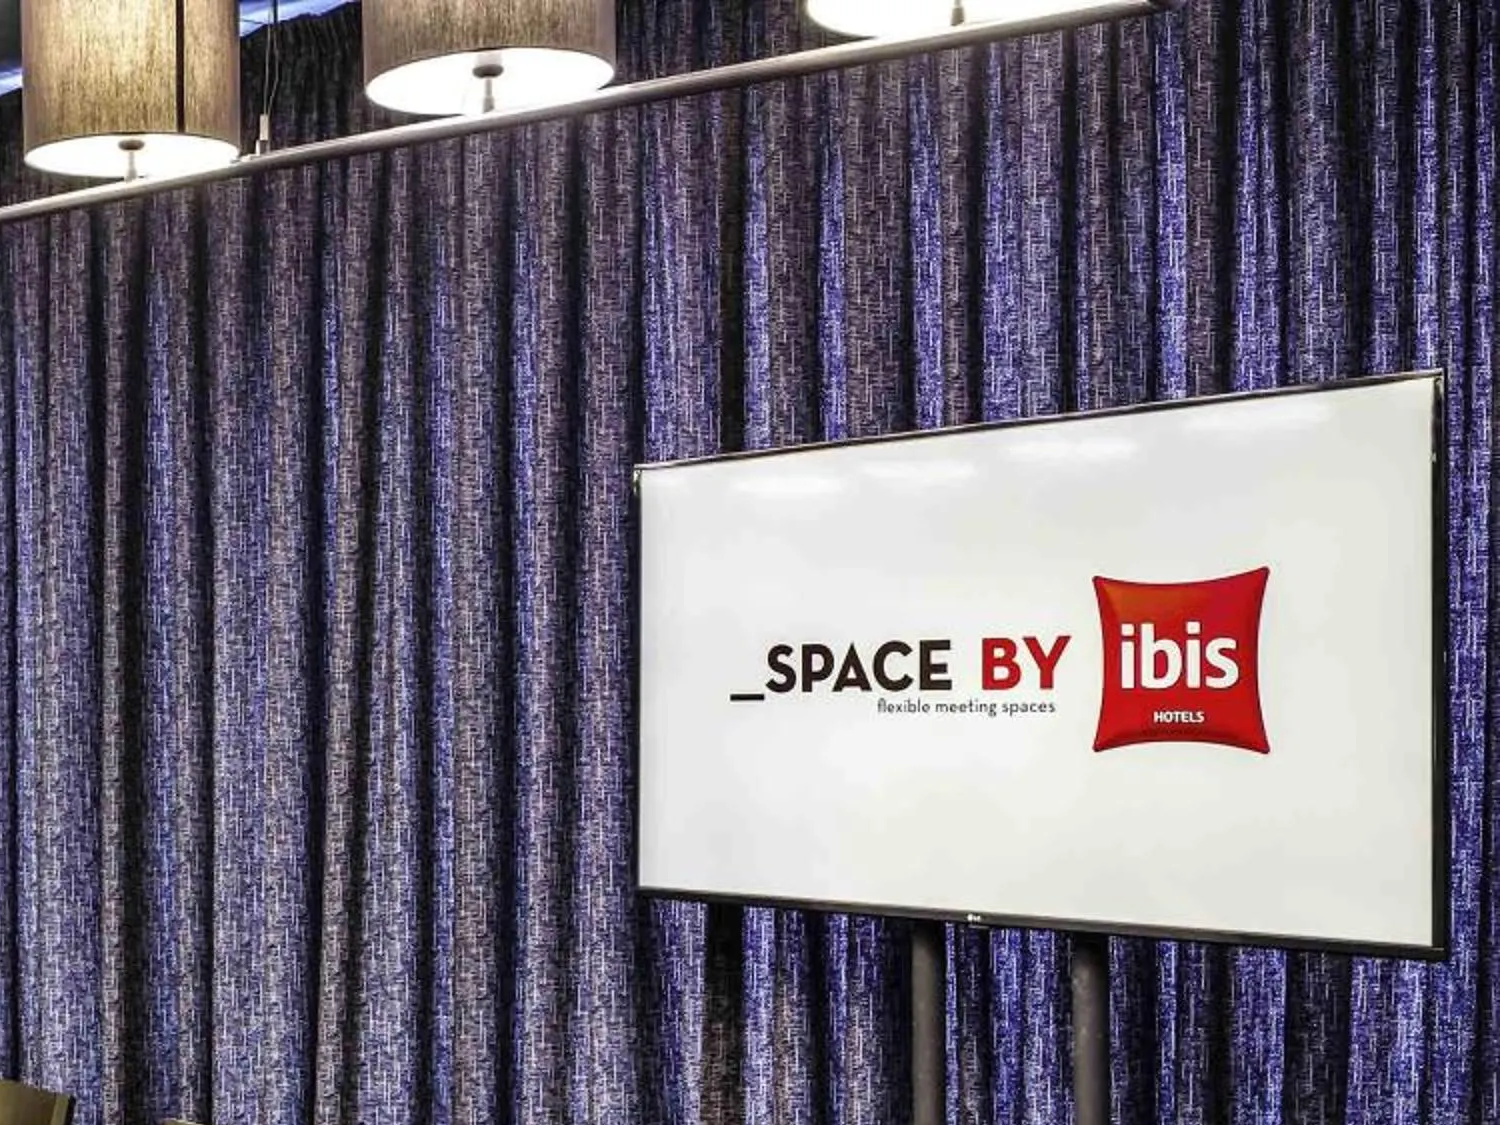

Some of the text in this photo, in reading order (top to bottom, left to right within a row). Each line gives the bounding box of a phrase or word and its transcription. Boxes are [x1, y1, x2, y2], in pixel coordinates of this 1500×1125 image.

[981, 635, 1072, 690] BY
[1121, 621, 1240, 689] ibis
[877, 697, 1056, 717] flexible meeting spaces
[1153, 711, 1204, 723] HOTELS
